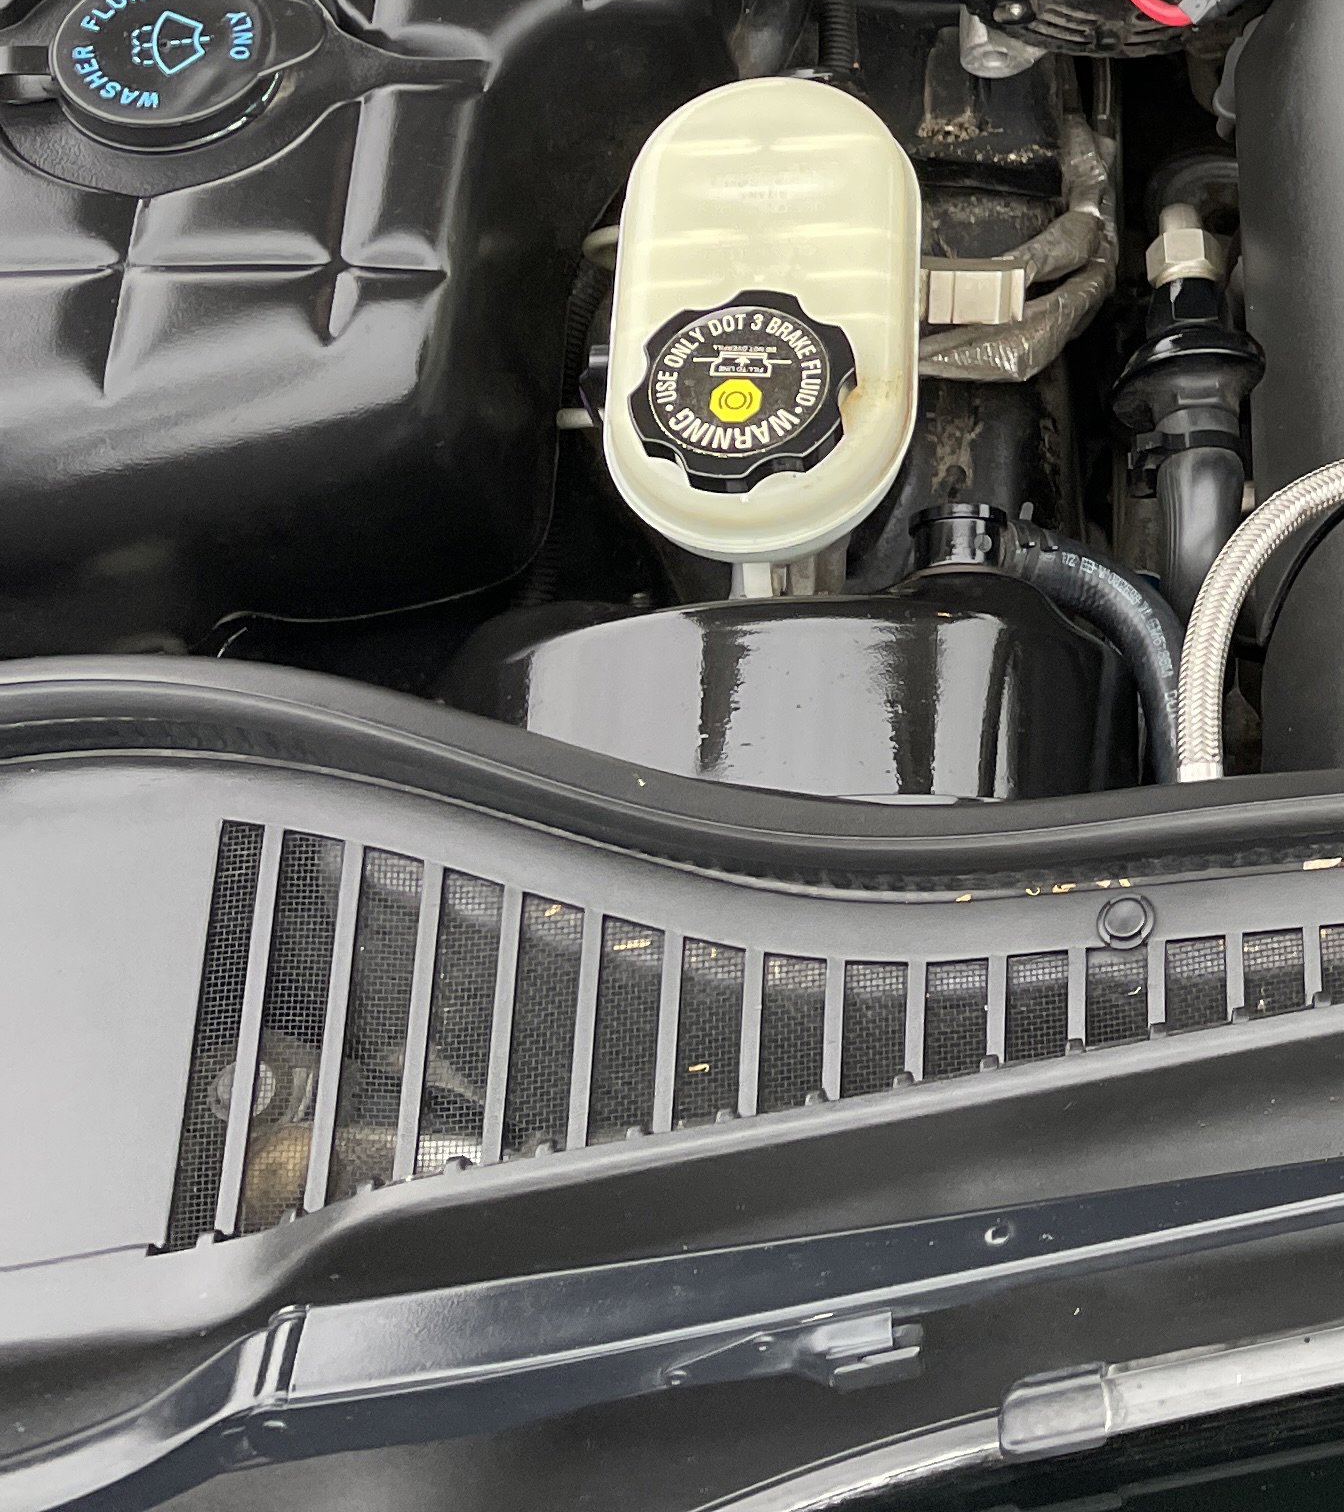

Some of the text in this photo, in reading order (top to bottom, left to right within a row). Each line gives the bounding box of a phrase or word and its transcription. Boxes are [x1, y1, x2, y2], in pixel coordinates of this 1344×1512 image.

[225, 11, 254, 61] ONLY
[71, 44, 160, 108] WASHER
[655, 313, 822, 408] USE ONLY DOT 3 BRAKE FLUID
[668, 408, 801, 450] WARNING
